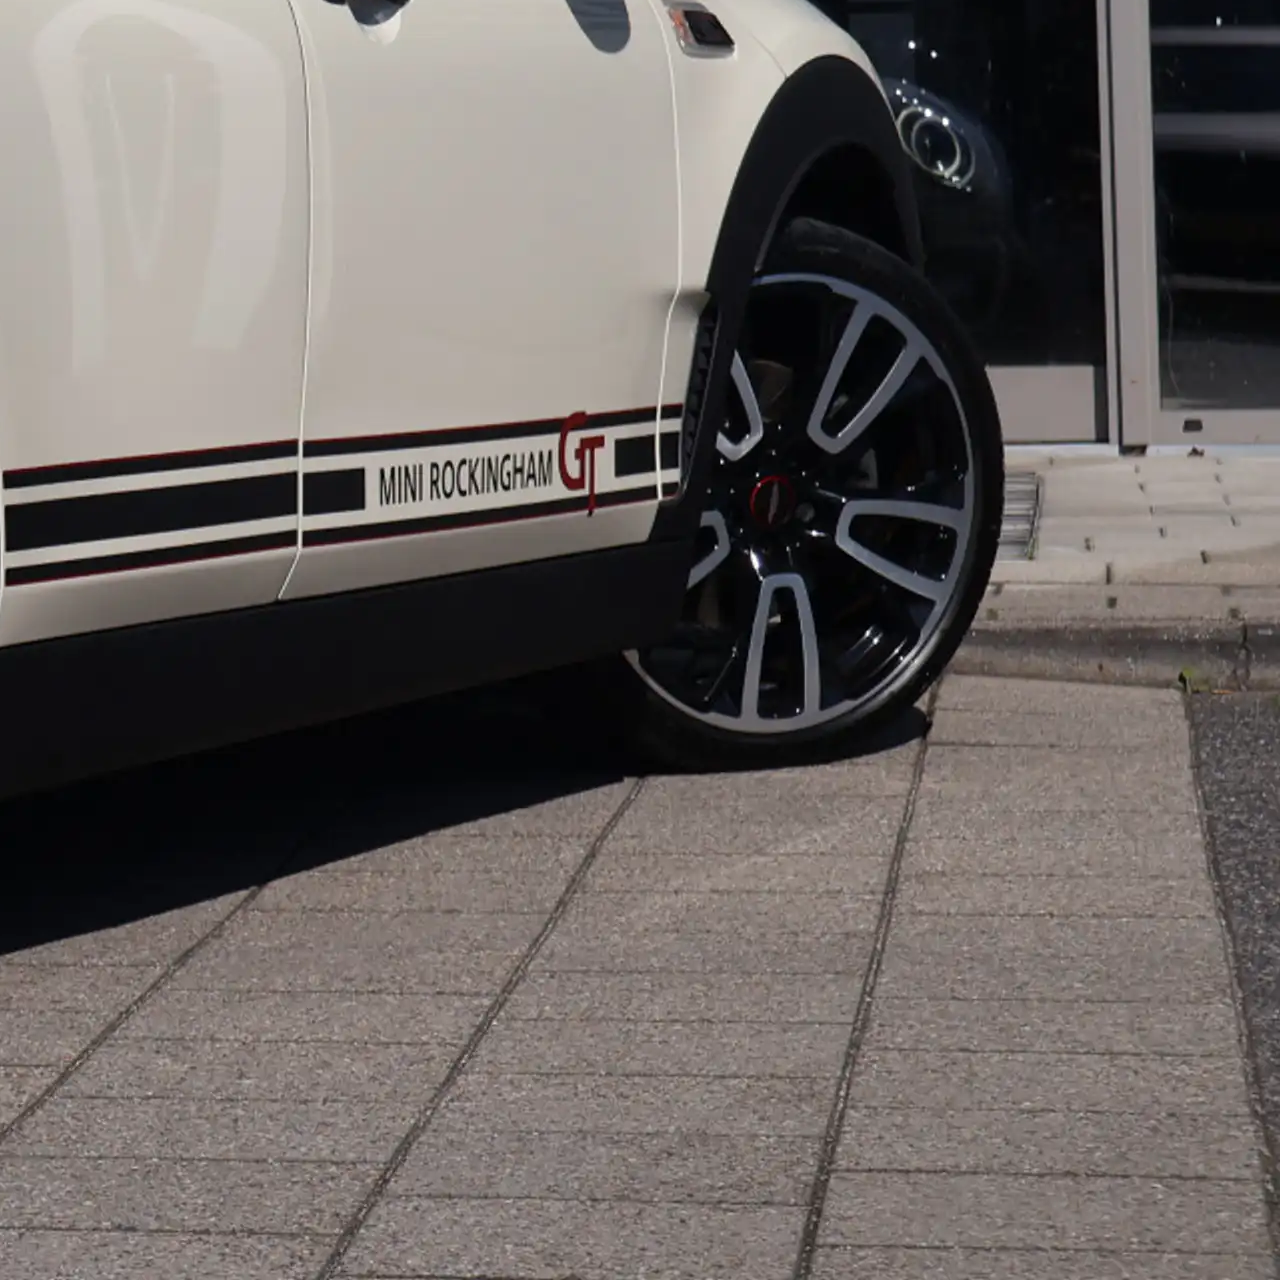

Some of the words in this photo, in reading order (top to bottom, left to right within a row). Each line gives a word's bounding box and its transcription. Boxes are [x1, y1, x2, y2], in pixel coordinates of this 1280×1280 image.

[378, 463, 424, 507] MINI
[429, 448, 553, 501] ROCKINGHAM
[558, 411, 605, 517] GT
